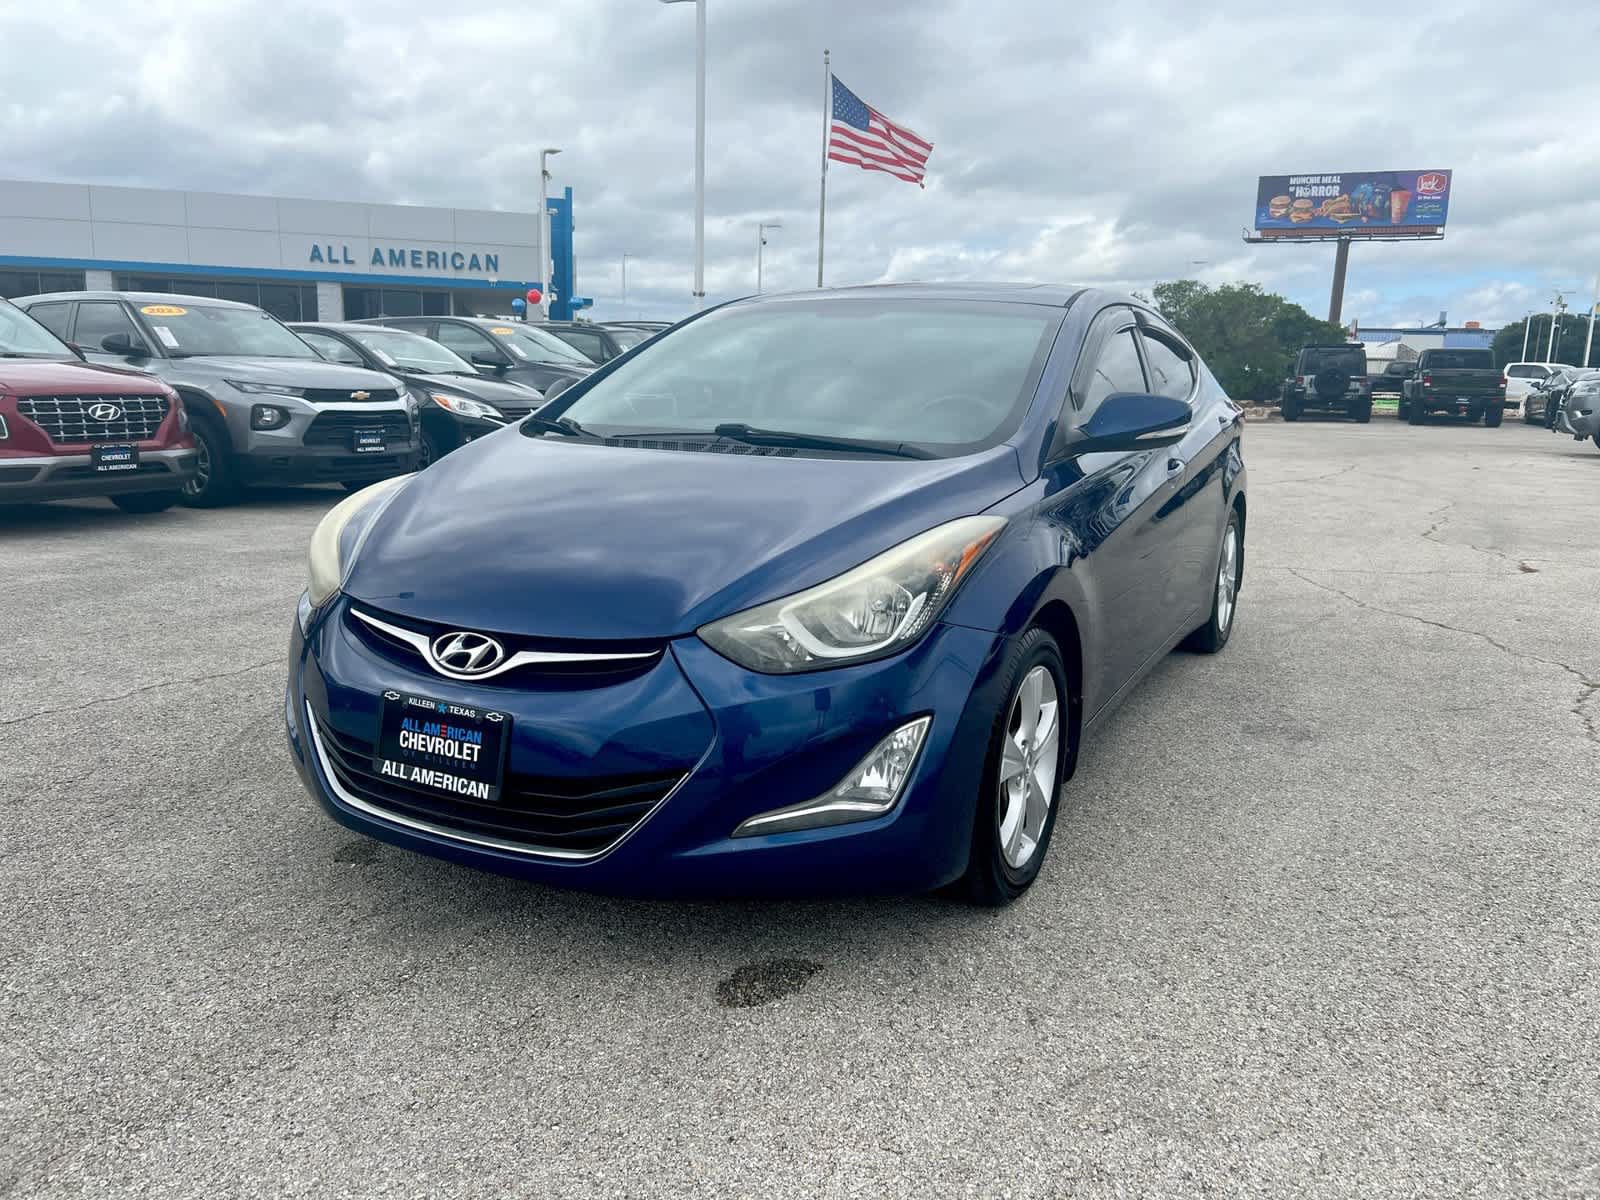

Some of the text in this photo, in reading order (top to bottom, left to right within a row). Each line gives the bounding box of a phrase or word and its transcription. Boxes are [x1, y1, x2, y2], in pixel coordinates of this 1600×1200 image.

[1321, 175, 1341, 184] MEAL
[309, 243, 499, 273] ALL AMERICAN
[408, 697, 476, 718] KILLEEN TEXAS
[401, 717, 482, 744] ALL AMERICAN
[399, 730, 481, 762] CHEVROLET
[381, 759, 489, 800] ALL AMERICAN
